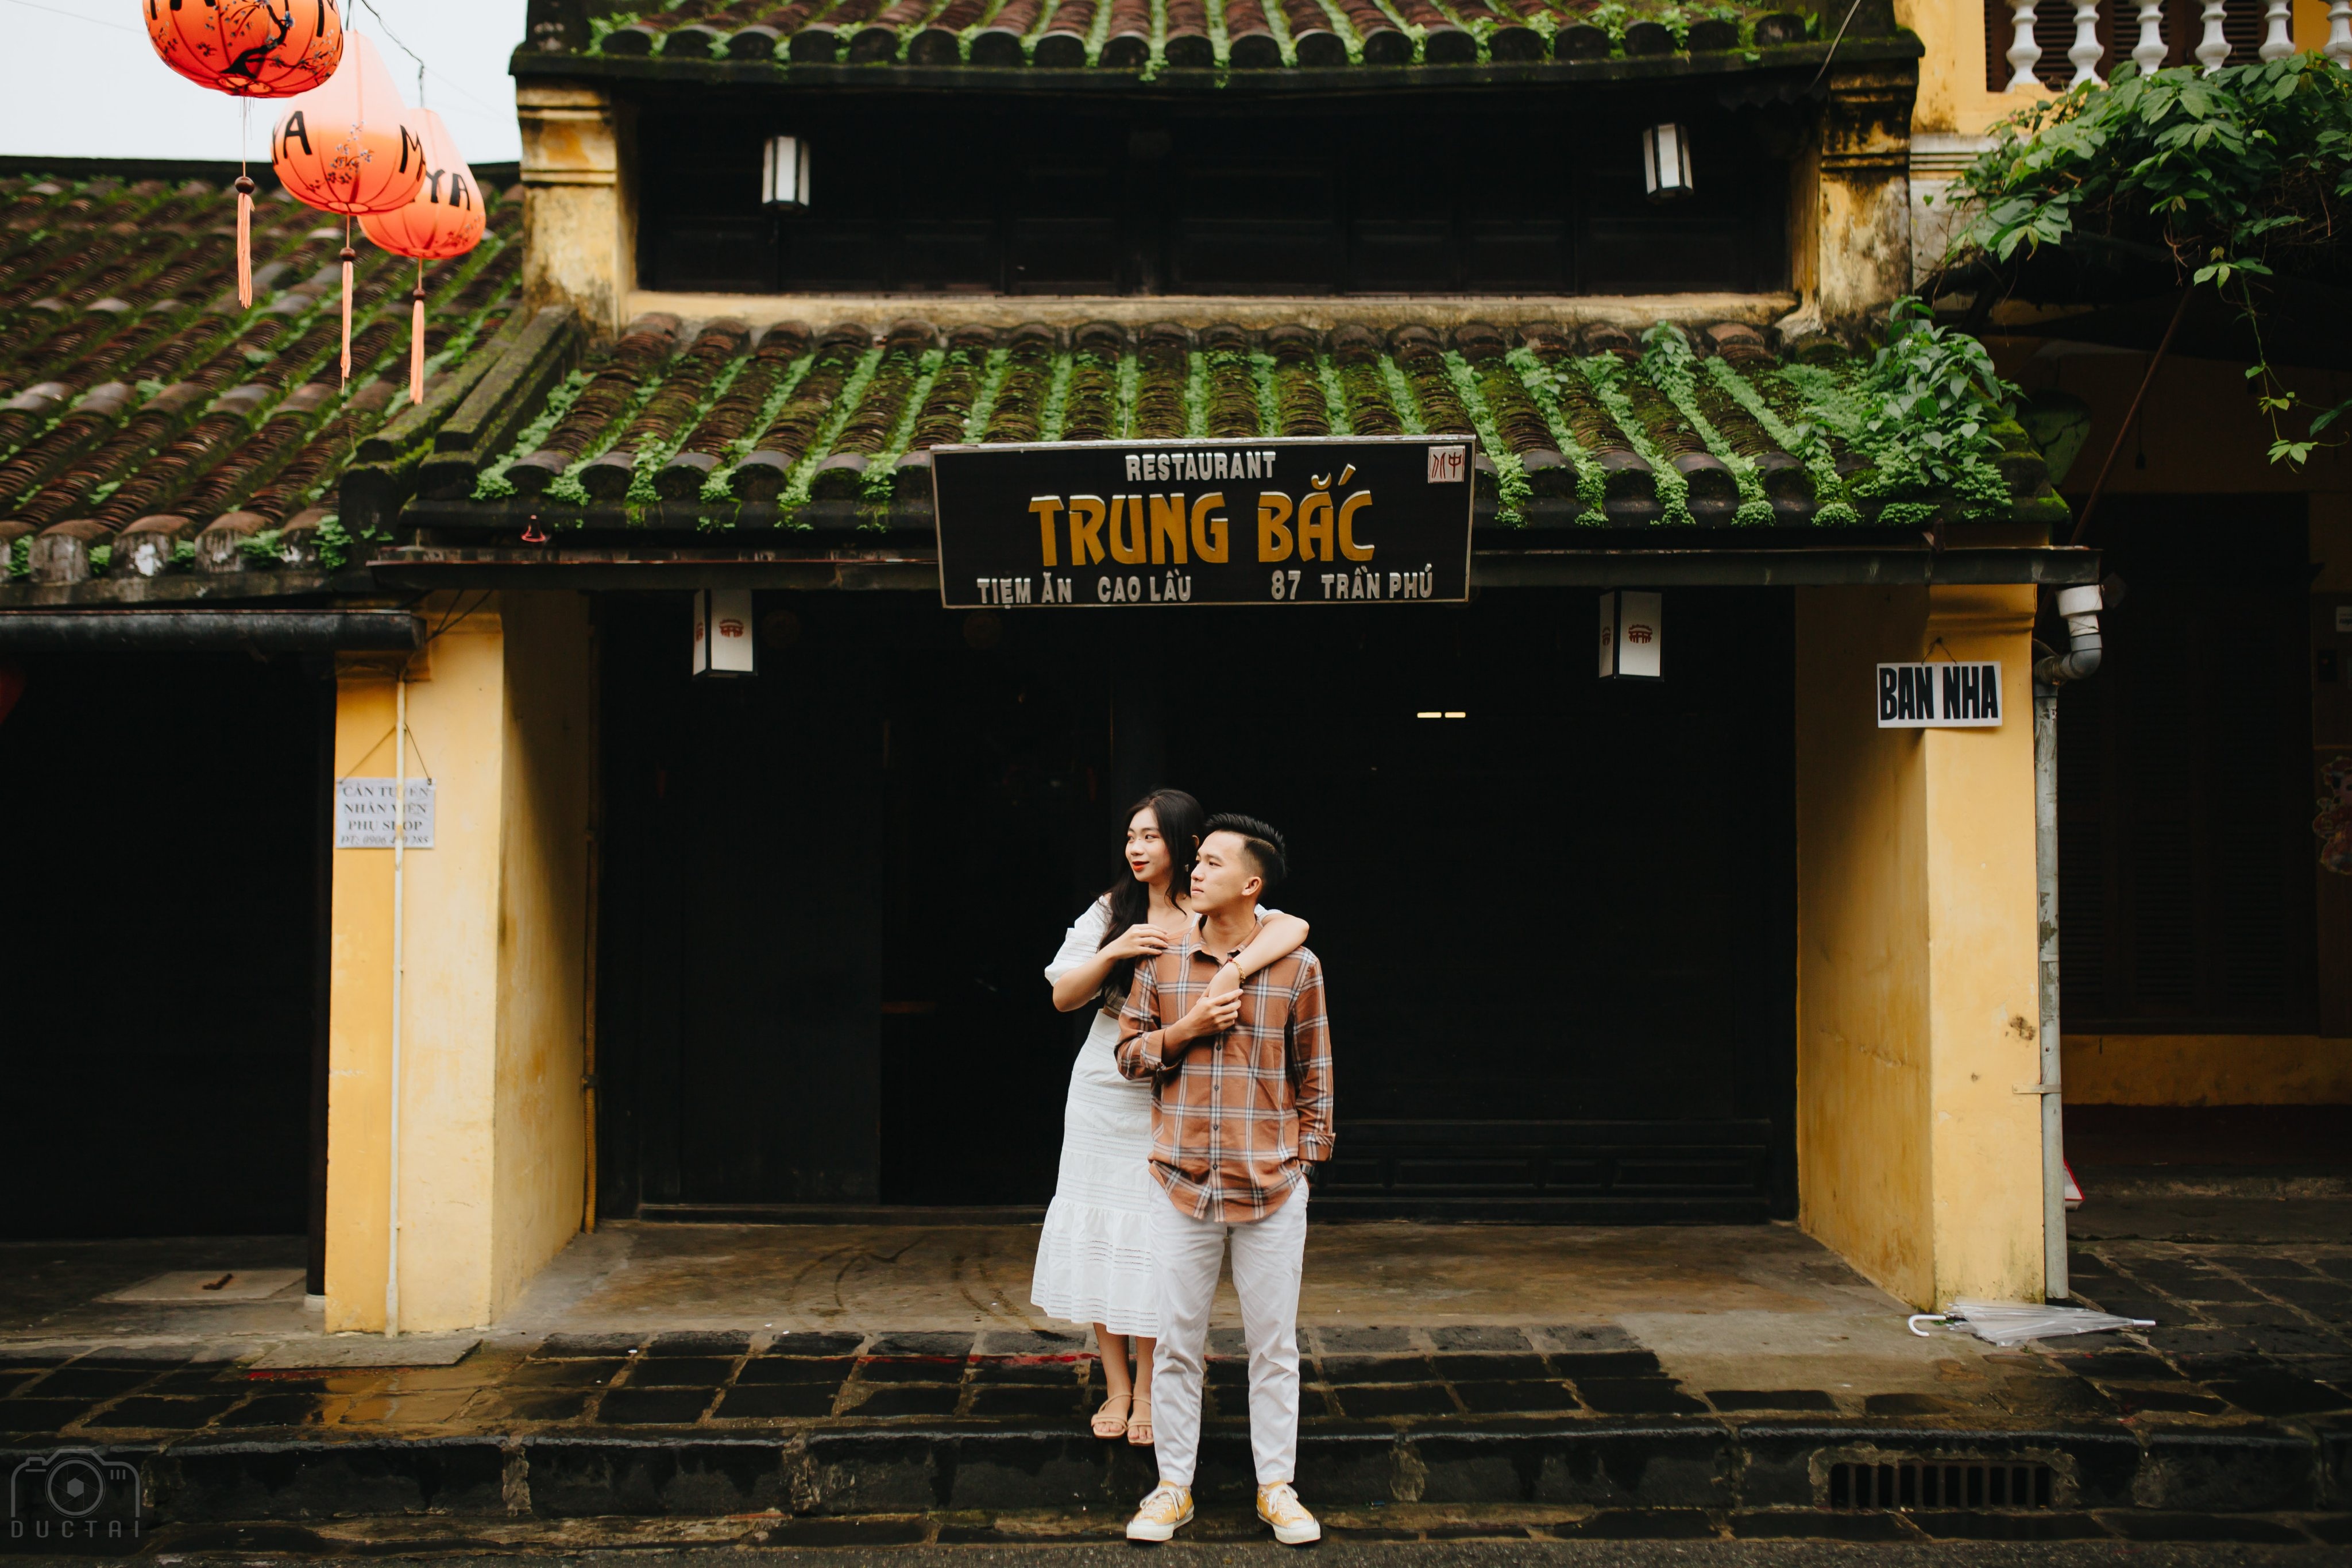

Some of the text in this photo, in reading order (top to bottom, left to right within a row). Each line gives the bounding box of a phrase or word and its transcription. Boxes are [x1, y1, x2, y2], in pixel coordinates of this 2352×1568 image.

[1125, 451, 1276, 481] RESTAURANT
[1029, 464, 1375, 566] TRUNG BẮC
[1098, 576, 1141, 603] CAO
[1150, 568, 1191, 603] LẦU
[1271, 570, 1301, 600] 87
[1321, 566, 1380, 600] TRẦN
[1389, 563, 1432, 598] PHÚ
[1879, 665, 1999, 720] BAN NHA
